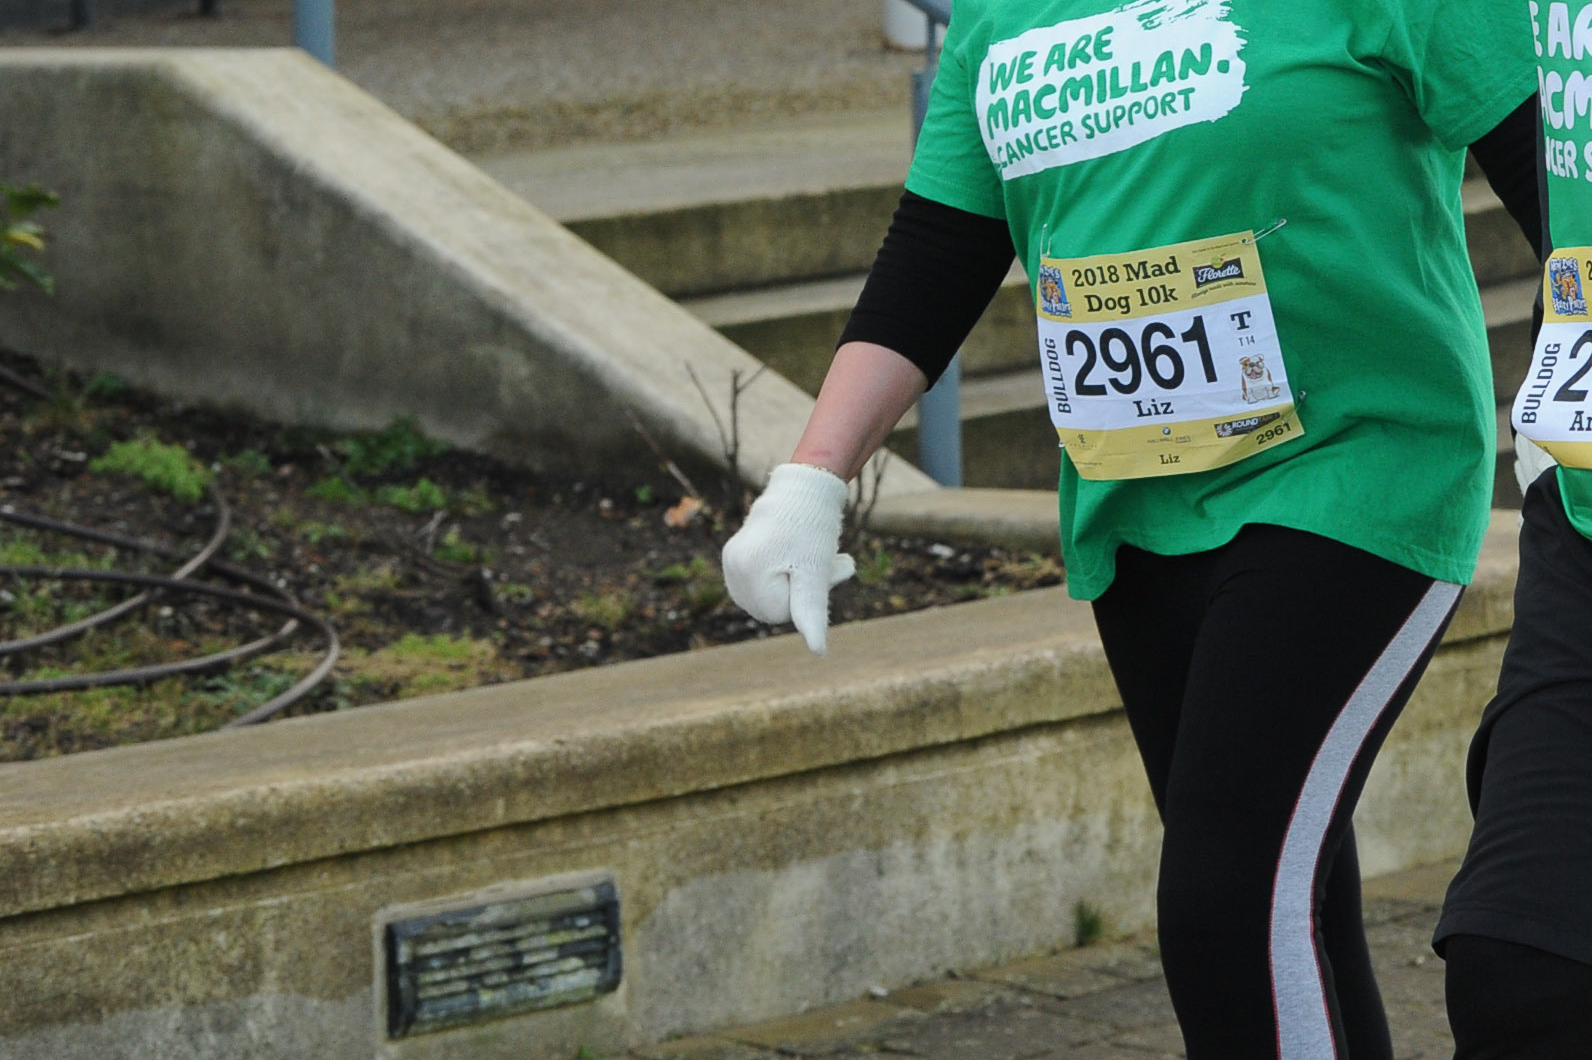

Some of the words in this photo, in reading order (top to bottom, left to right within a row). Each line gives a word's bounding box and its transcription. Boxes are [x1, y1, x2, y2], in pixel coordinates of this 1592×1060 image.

[989, 50, 1037, 95] WE
[1043, 25, 1114, 77] ARE
[986, 42, 1230, 140] MACMILLAN.
[996, 120, 1078, 169] CANCER
[1085, 87, 1196, 140] SUPPORT
[1071, 264, 1121, 288] 2018
[1123, 256, 1181, 282] Mad
[1197, 264, 1241, 283] Florette
[1084, 293, 1131, 315] Dog
[1138, 284, 1179, 307] 10k
[1230, 310, 1251, 330] T
[1065, 315, 1218, 397] 2961
[1044, 338, 1072, 414] BULLDOG
[1521, 343, 1561, 424] BULLDOG
[1133, 399, 1174, 418] Liz
[1256, 422, 1291, 445] 2961
[1159, 454, 1180, 465] Liz
